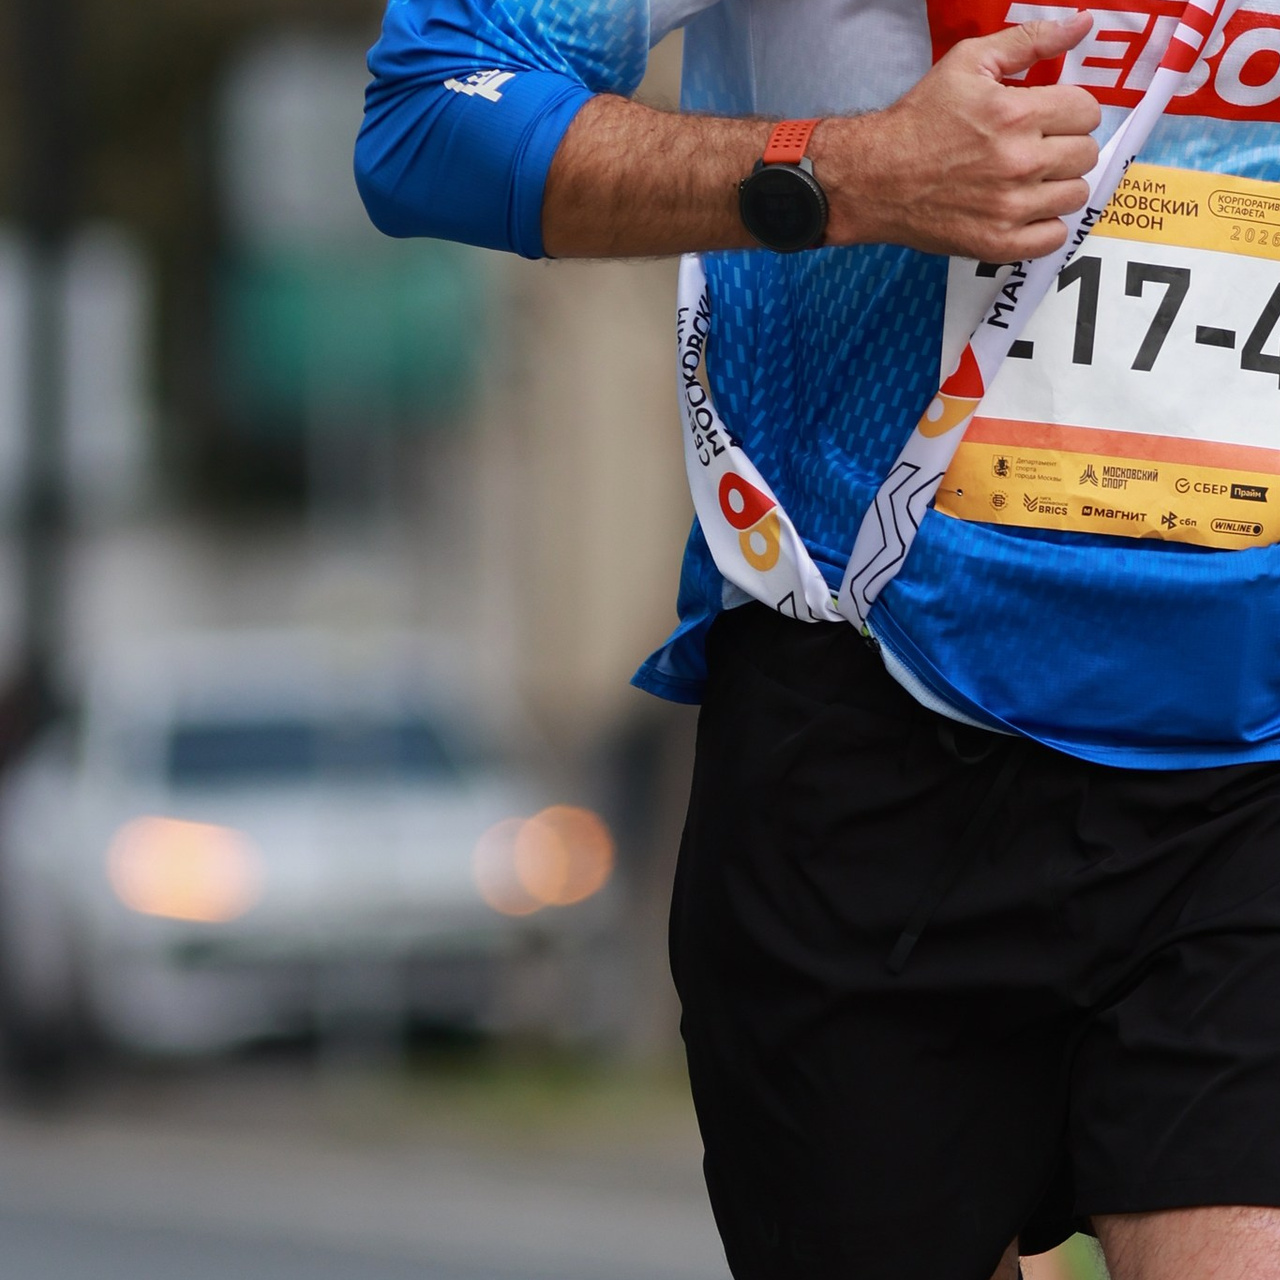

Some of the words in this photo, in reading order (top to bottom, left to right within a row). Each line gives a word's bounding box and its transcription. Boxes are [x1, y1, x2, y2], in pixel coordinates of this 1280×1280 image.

[1106, 192, 1199, 218] КОВСКИЙ
[1217, 204, 1265, 219] ЭСТАФЕТА
[1099, 209, 1164, 231] РАФОН
[1102, 466, 1159, 482] МОСКОВСКИЙ
[1101, 477, 1128, 490] СПОРТ
[1193, 482, 1228, 495] СБЕР
[1233, 487, 1262, 498] Прайм
[1038, 505, 1068, 515] BRICS
[1179, 518, 1197, 527] сбп
[1214, 521, 1252, 533] WINLINE
